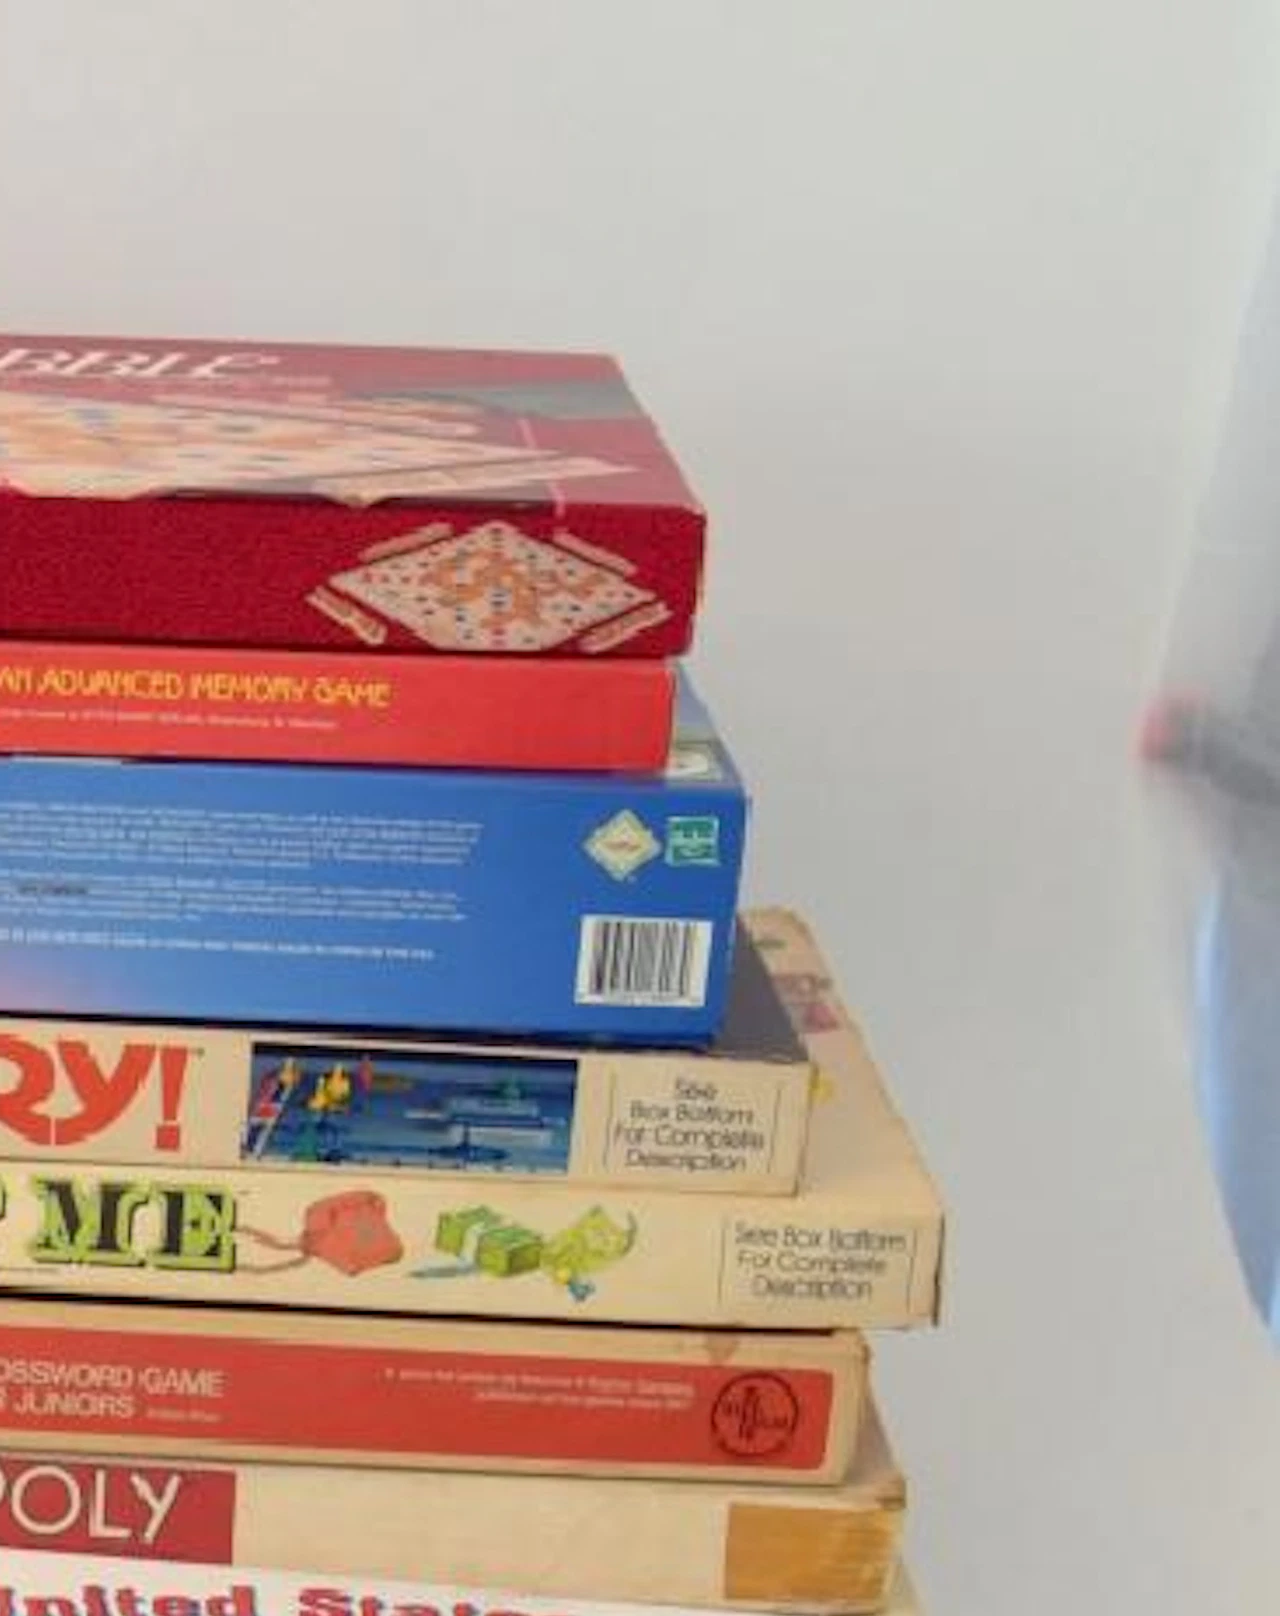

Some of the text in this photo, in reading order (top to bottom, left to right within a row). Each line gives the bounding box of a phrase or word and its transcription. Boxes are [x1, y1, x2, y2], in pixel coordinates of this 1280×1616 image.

[41, 665, 185, 702] ADVANCED
[191, 672, 306, 706] MEMORY
[311, 677, 394, 710] GAME
[31, 1167, 239, 1272] ME
[142, 1366, 227, 1399] GAME
[13, 1391, 137, 1420] JUNIORS
